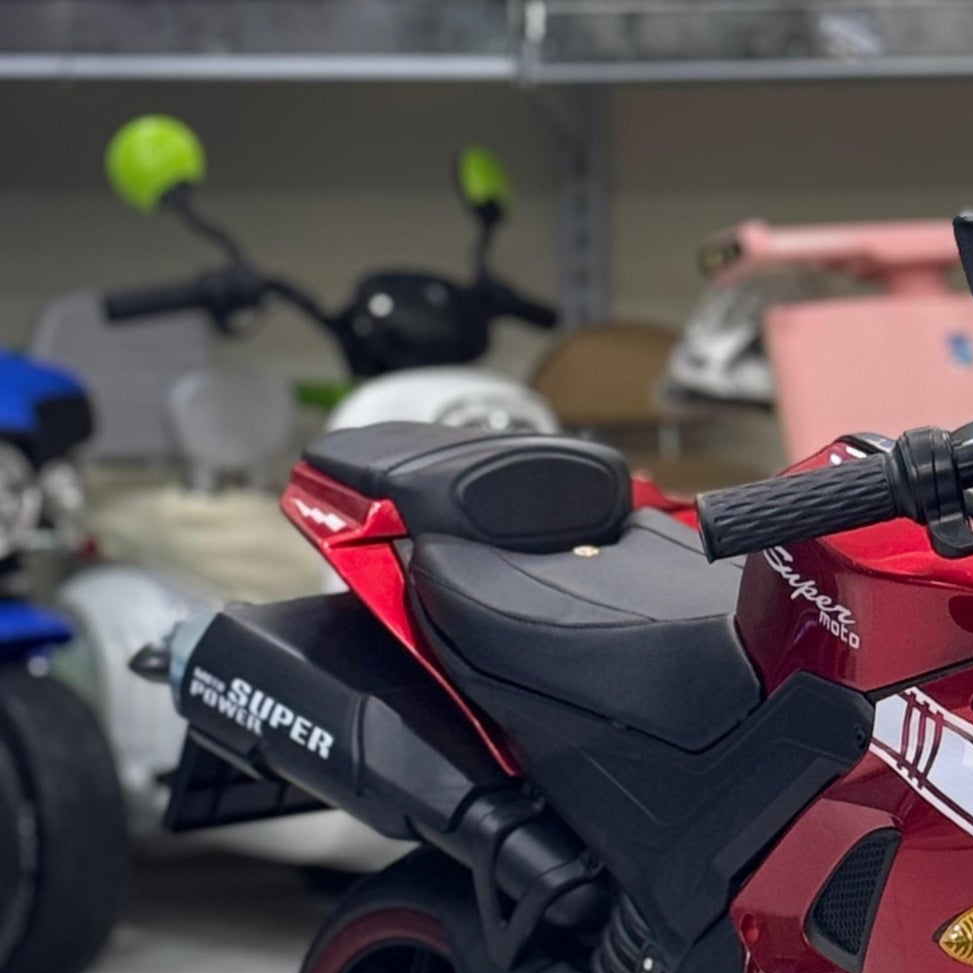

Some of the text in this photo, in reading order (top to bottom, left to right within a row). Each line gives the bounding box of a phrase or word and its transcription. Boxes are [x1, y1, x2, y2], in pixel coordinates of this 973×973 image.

[763, 546, 856, 624] Super
[189, 679, 263, 737] POWER
[227, 678, 335, 760] SUPER
